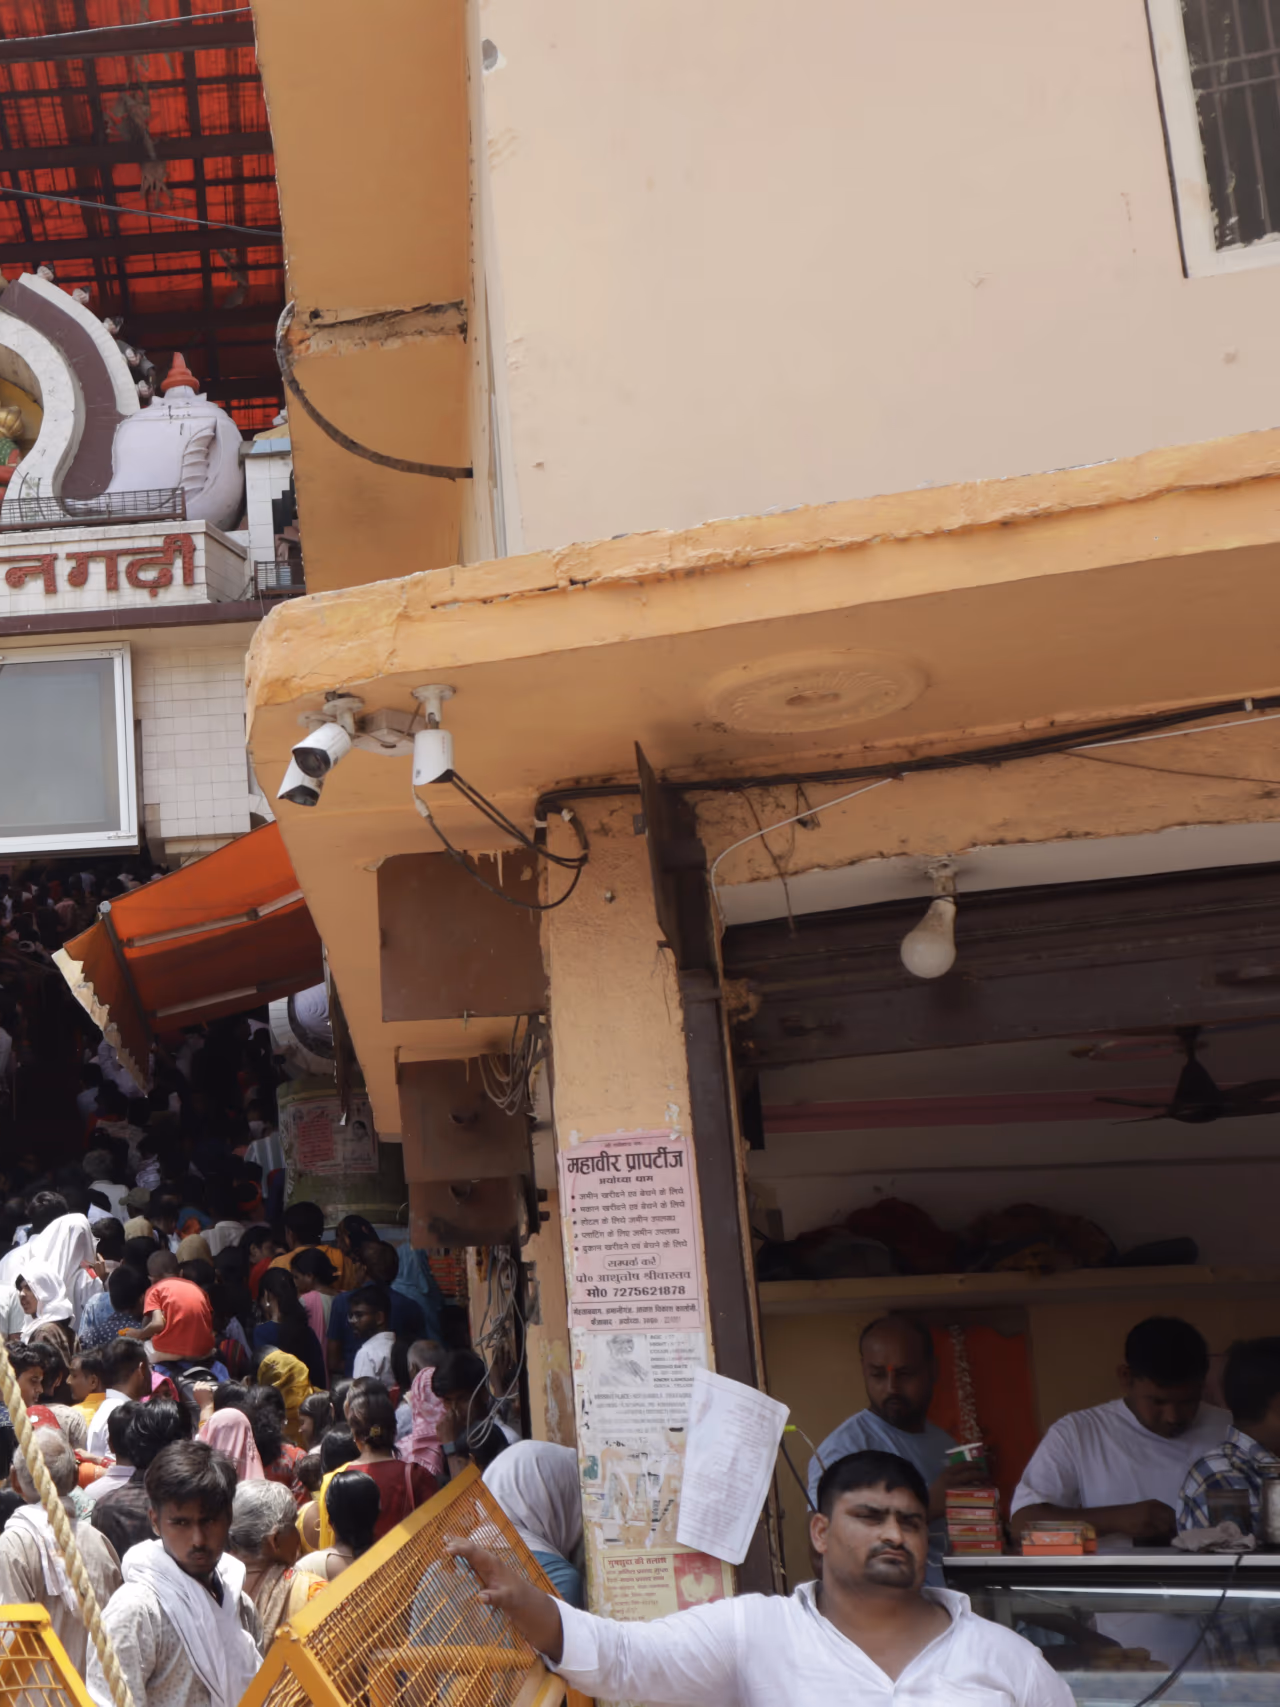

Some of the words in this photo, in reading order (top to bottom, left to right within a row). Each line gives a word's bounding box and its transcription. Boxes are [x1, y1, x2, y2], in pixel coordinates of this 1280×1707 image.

[65, 533, 197, 597] गढ़ी
[567, 1150, 622, 1175] महावीर
[625, 1146, 684, 1173] प्रापर्टीज
[635, 1175, 654, 1183] धाम
[579, 1191, 599, 1201] जमीन
[580, 1205, 600, 1213] मकान
[613, 1285, 686, 1297] 7275621878
